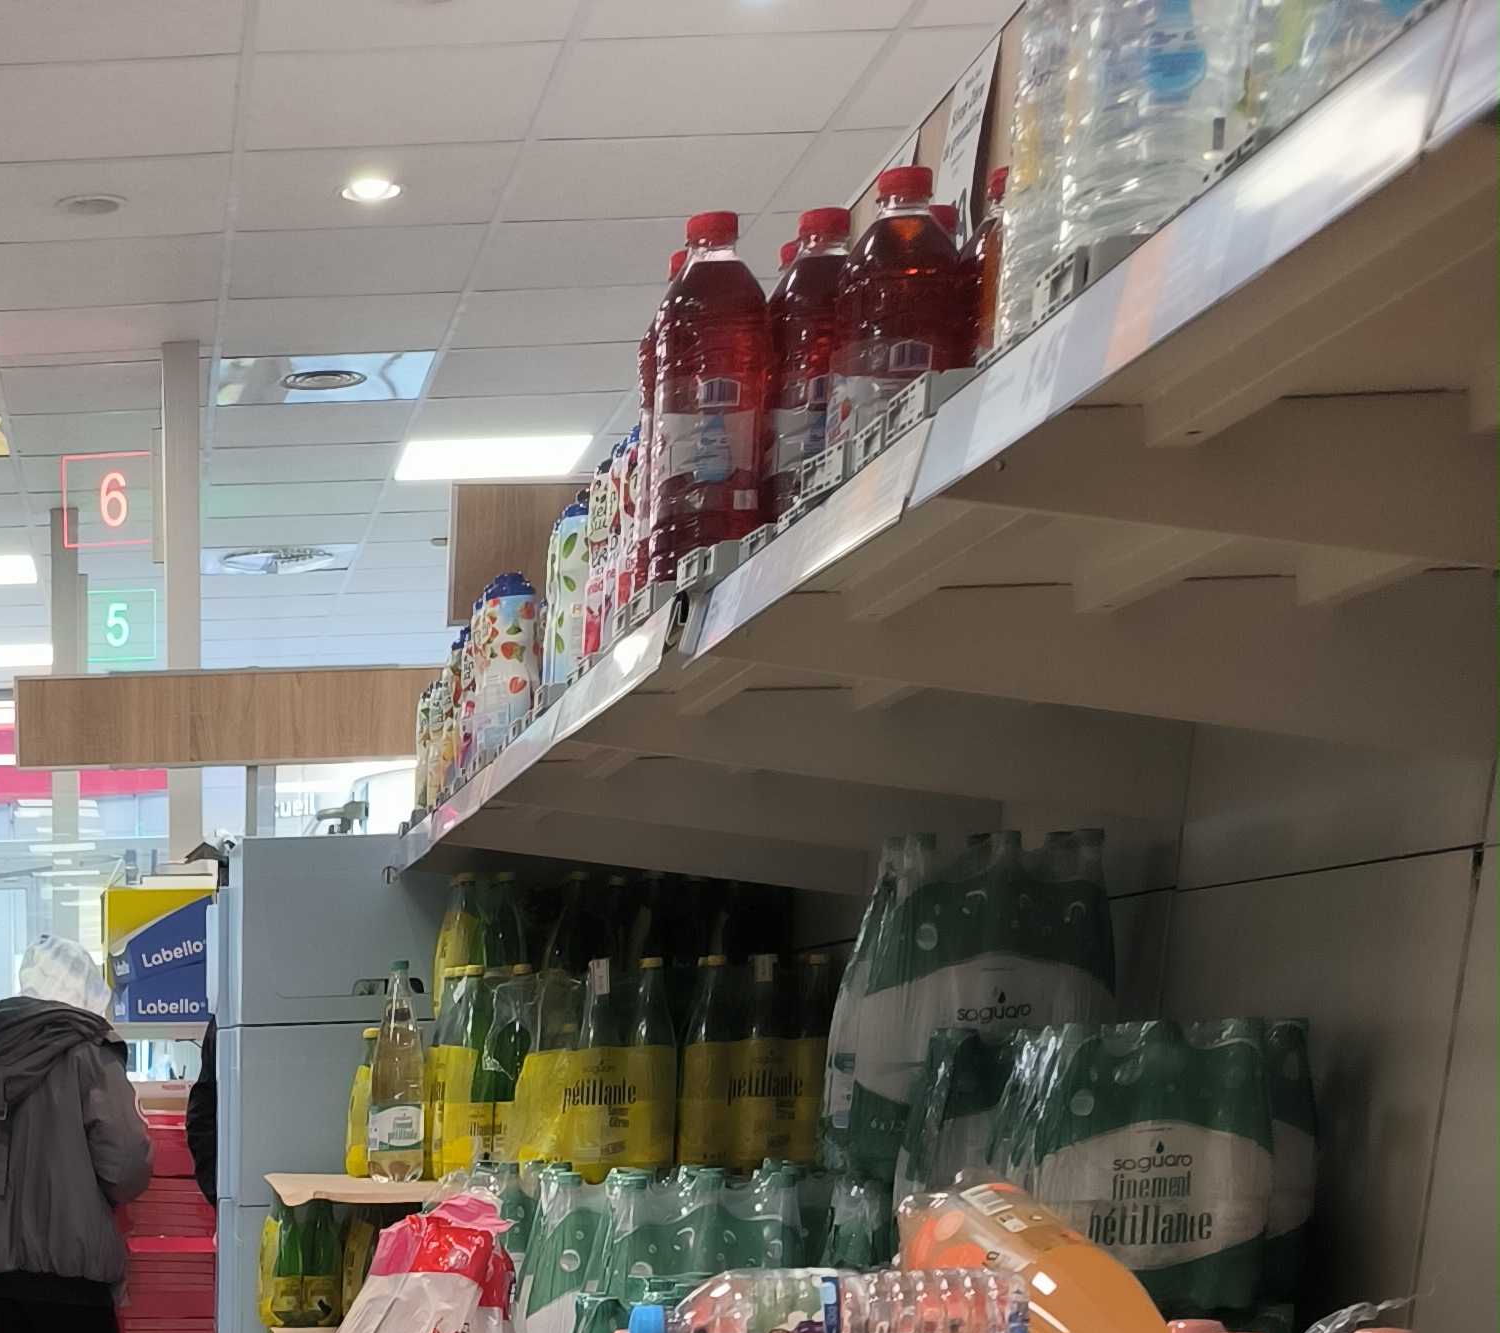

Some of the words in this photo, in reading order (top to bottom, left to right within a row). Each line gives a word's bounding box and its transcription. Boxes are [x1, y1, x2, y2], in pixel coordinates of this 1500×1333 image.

[100, 472, 128, 527] 6
[106, 602, 130, 647] 5
[141, 940, 204, 968] Labello
[137, 998, 200, 1015] Labello
[957, 1003, 1032, 1025] saguaro
[561, 1077, 637, 1114] pétillante
[1112, 1154, 1193, 1173] saguaro
[1112, 1170, 1192, 1200] finement
[1088, 1202, 1213, 1246] pétillante
